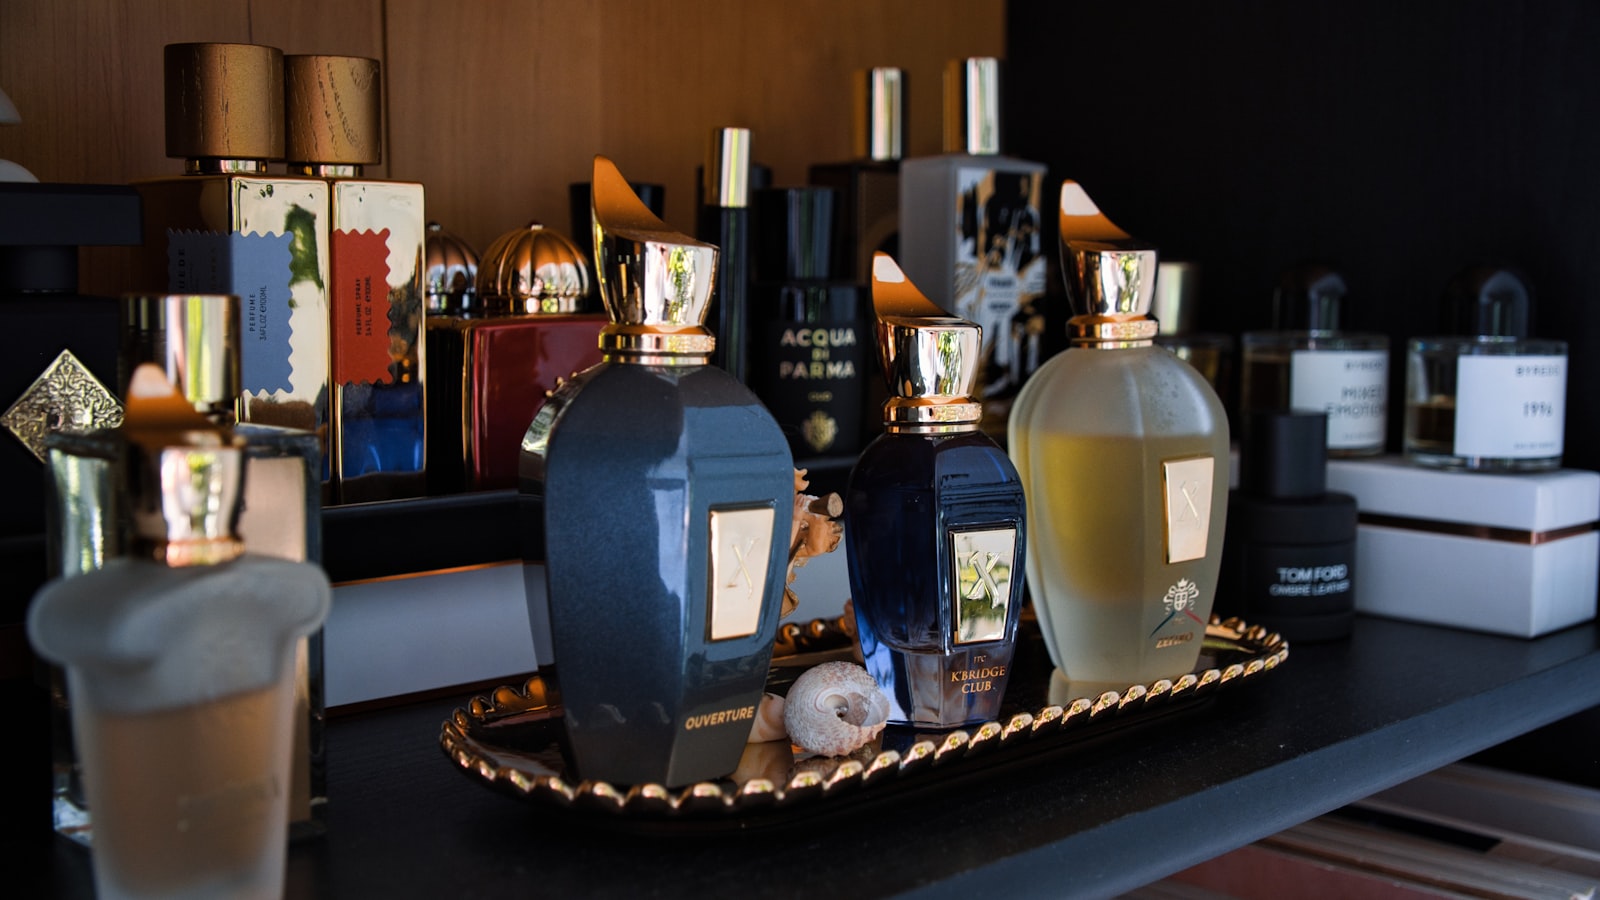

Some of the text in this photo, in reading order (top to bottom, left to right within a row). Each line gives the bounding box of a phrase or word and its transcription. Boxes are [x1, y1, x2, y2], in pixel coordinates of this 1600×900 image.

[780, 328, 856, 347] ACQUA
[780, 361, 855, 379] PARMA
[1276, 564, 1347, 583] TOM FORD
[951, 665, 1006, 682] K'BRIDGE
[961, 680, 992, 694] CLUB
[685, 706, 755, 730] OUVERTURE
